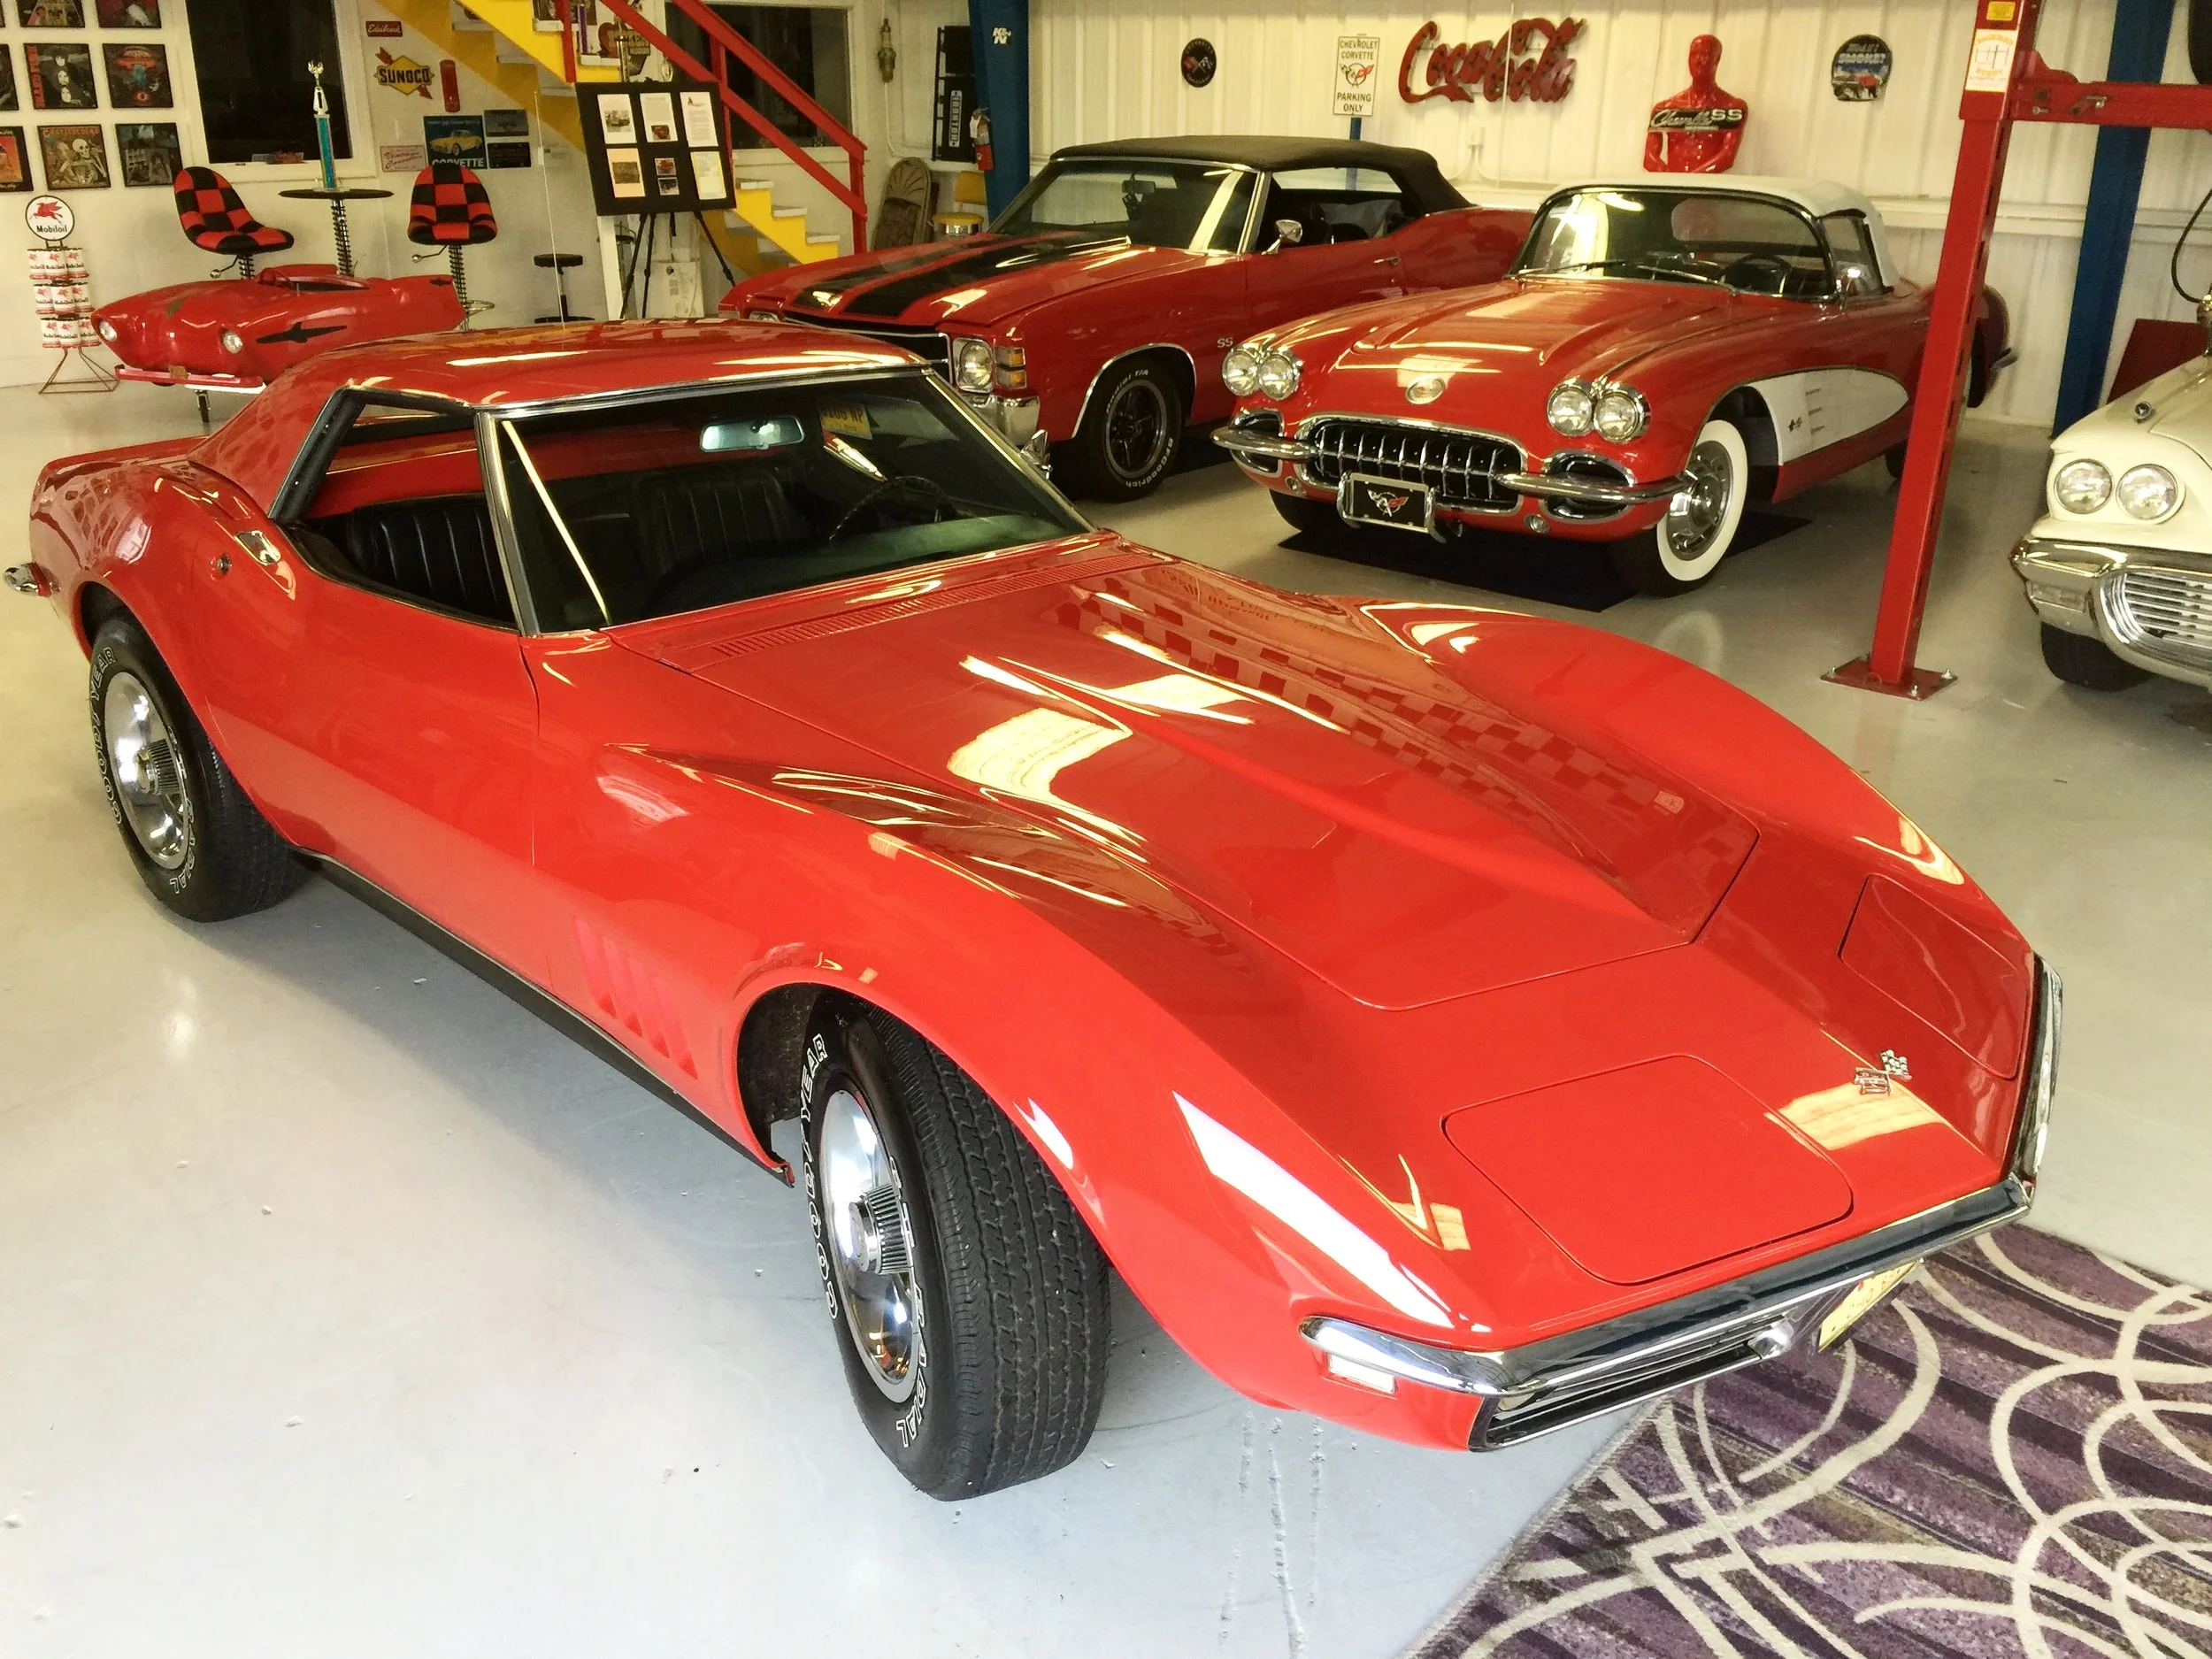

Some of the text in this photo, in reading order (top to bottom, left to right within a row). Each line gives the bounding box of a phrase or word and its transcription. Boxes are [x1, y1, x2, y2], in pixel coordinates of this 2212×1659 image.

[1340, 40, 1379, 49] CHEVROLET
[379, 67, 430, 83] SUNOCO
[1337, 92, 1372, 102] PARKING
[1343, 104, 1363, 112] ONLY
[1710, 108, 1743, 121] SS
[36, 225, 67, 234] Mobiloil
[1217, 336, 1233, 348] SS
[91, 647, 121, 825] GOODYEAR
[801, 1033, 838, 1319] GOODYEAR
[896, 1283, 927, 1448] RADIAL
